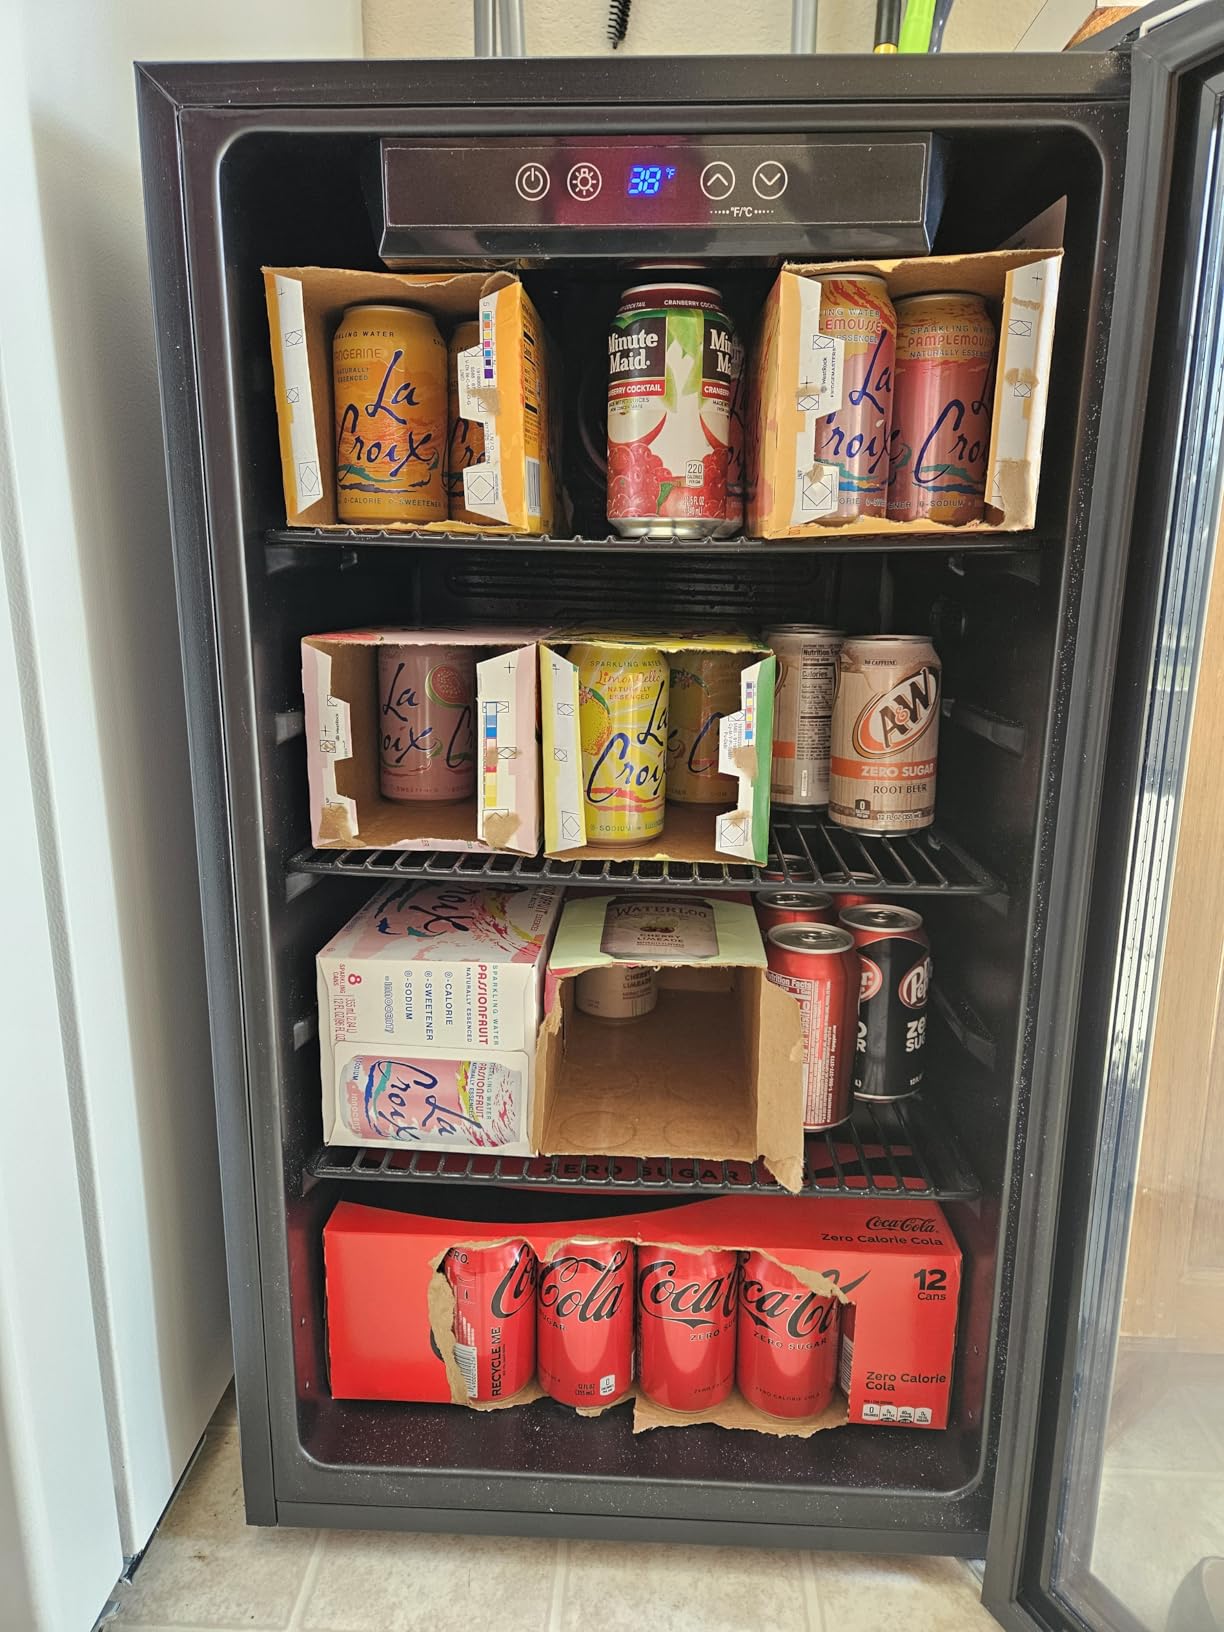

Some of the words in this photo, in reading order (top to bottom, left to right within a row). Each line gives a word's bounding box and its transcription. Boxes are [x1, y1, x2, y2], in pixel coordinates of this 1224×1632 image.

[628, 166, 662, 195] 38
[664, 299, 699, 307] CRANBERRY
[849, 308, 880, 317] WATER
[910, 324, 969, 334] SPARKLING
[608, 329, 659, 355] Minute
[909, 348, 958, 358] NATURALLY
[848, 329, 892, 414] La
[365, 349, 421, 425] La
[626, 383, 662, 394] COCKTAIL
[337, 403, 438, 482] Croix
[687, 463, 703, 474] 220
[802, 648, 830, 657] Nutrition
[590, 660, 639, 668] SPARKLING
[801, 671, 828, 679] Calories
[383, 662, 420, 722] La
[637, 680, 669, 747] La
[879, 667, 933, 749] A&W
[861, 766, 899, 777] ZERO
[901, 764, 936, 777] SUGAR
[873, 784, 902, 795] ROOT
[906, 783, 928, 794] BEER
[859, 801, 865, 810] 0
[615, 904, 707, 918] WATERLOO
[347, 973, 362, 986] 8
[791, 980, 812, 989] Facts
[477, 963, 489, 1045] PASSIONFRUIT
[476, 1062, 487, 1119] PASSIONFRUIT
[377, 1060, 440, 1142] Croix
[421, 1095, 483, 1136] La
[543, 1163, 623, 1176] ZERO
[641, 1166, 741, 1181] SUGAR
[821, 1233, 855, 1243] Zero
[857, 1233, 907, 1244] Calorie
[911, 1237, 943, 1246] Cola
[537, 1244, 629, 1323] Cola
[914, 1269, 947, 1291] 12
[917, 1291, 946, 1301] Cans
[490, 1327, 501, 1344] ME
[689, 1329, 720, 1341] ZERO
[753, 1330, 783, 1349] ZERO
[788, 1337, 827, 1351] SUGAR
[491, 1346, 502, 1397] RECYCLE
[866, 1370, 897, 1382] Zero
[900, 1373, 947, 1384] Calorie
[865, 1381, 896, 1392] Cola
